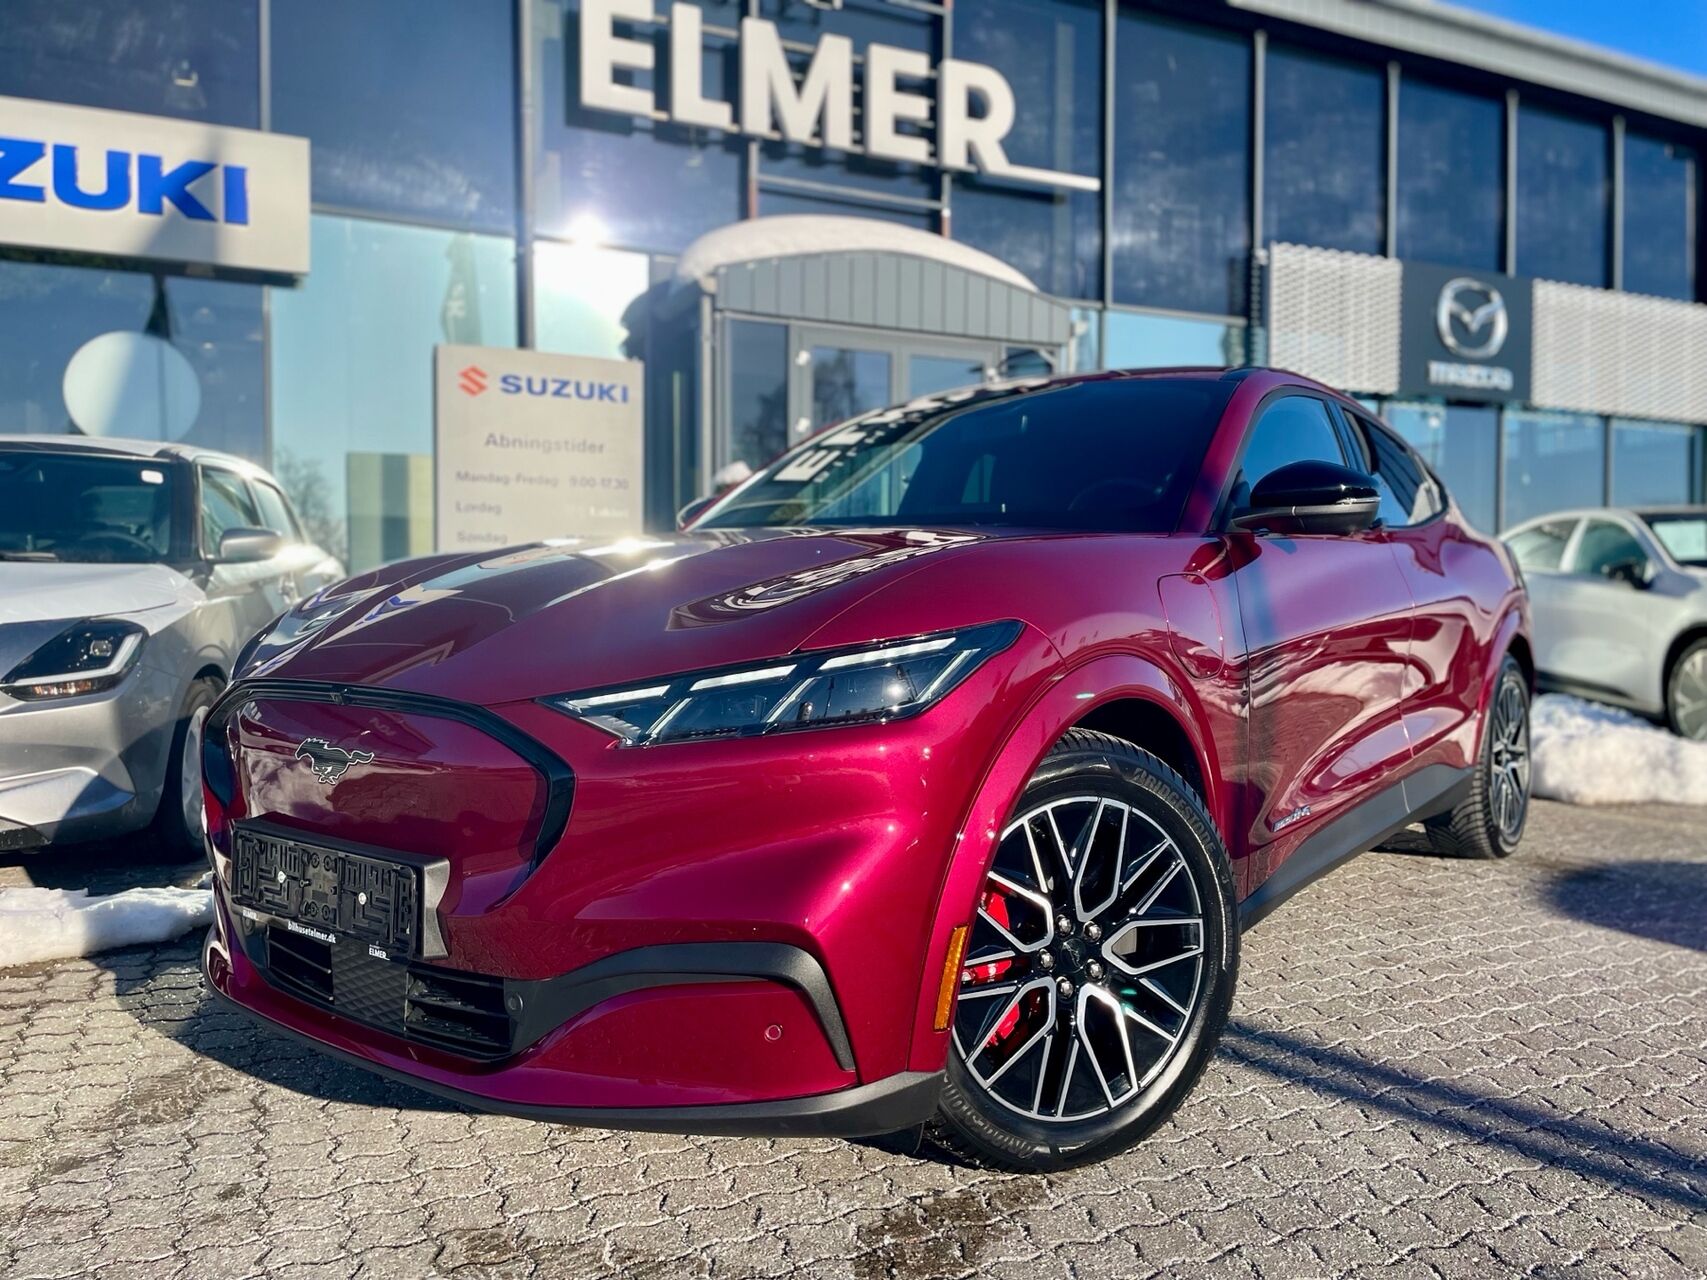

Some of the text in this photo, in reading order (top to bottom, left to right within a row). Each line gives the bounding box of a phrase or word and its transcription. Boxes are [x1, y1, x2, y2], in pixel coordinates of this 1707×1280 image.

[580, 0, 1100, 191] ELMER
[499, 374, 630, 404] SUZUKI
[287, 920, 337, 944] bilhusetelmer.dk
